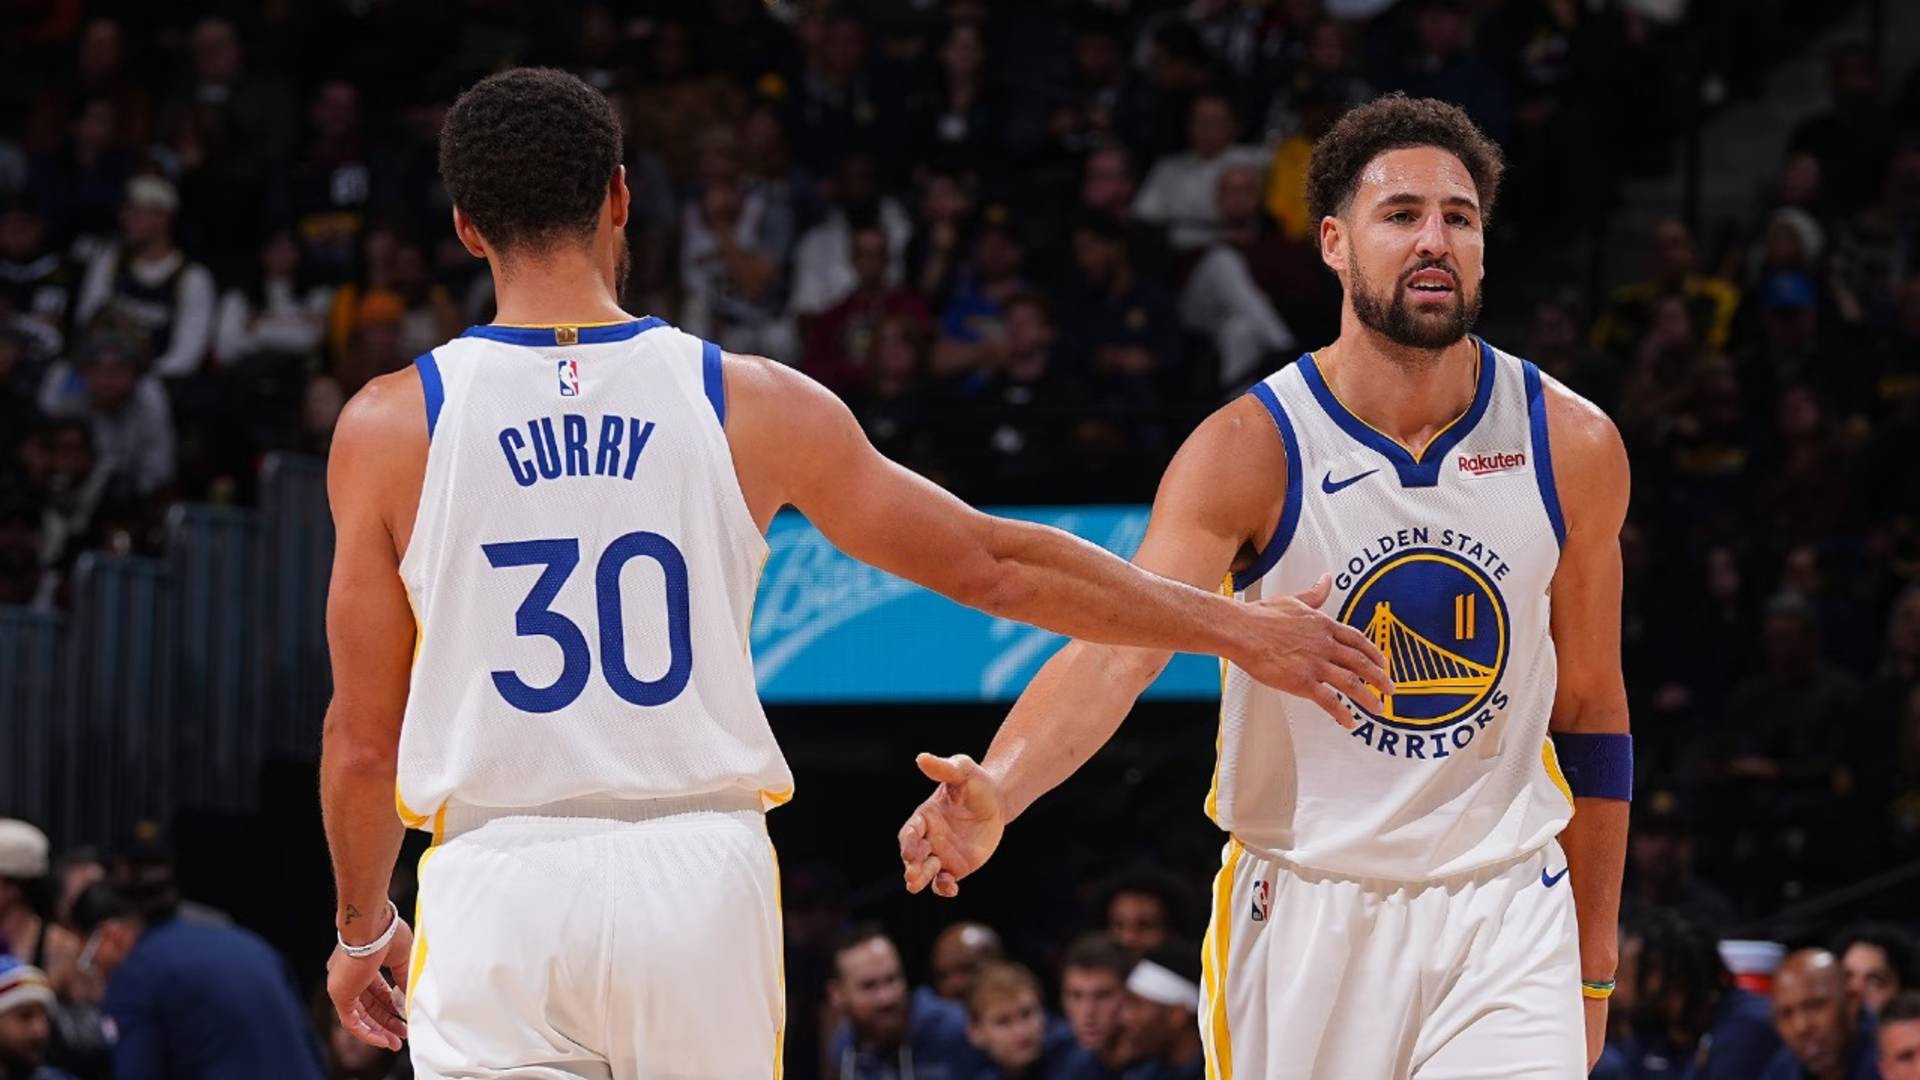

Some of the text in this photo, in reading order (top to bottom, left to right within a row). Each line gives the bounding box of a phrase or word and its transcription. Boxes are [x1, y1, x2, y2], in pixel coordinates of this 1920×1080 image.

[499, 414, 656, 487] CURRY
[1458, 452, 1526, 472] Rakuten
[1335, 527, 1511, 591] GOLDEN STATE
[480, 531, 693, 713] 30
[1455, 592, 1475, 640] 11
